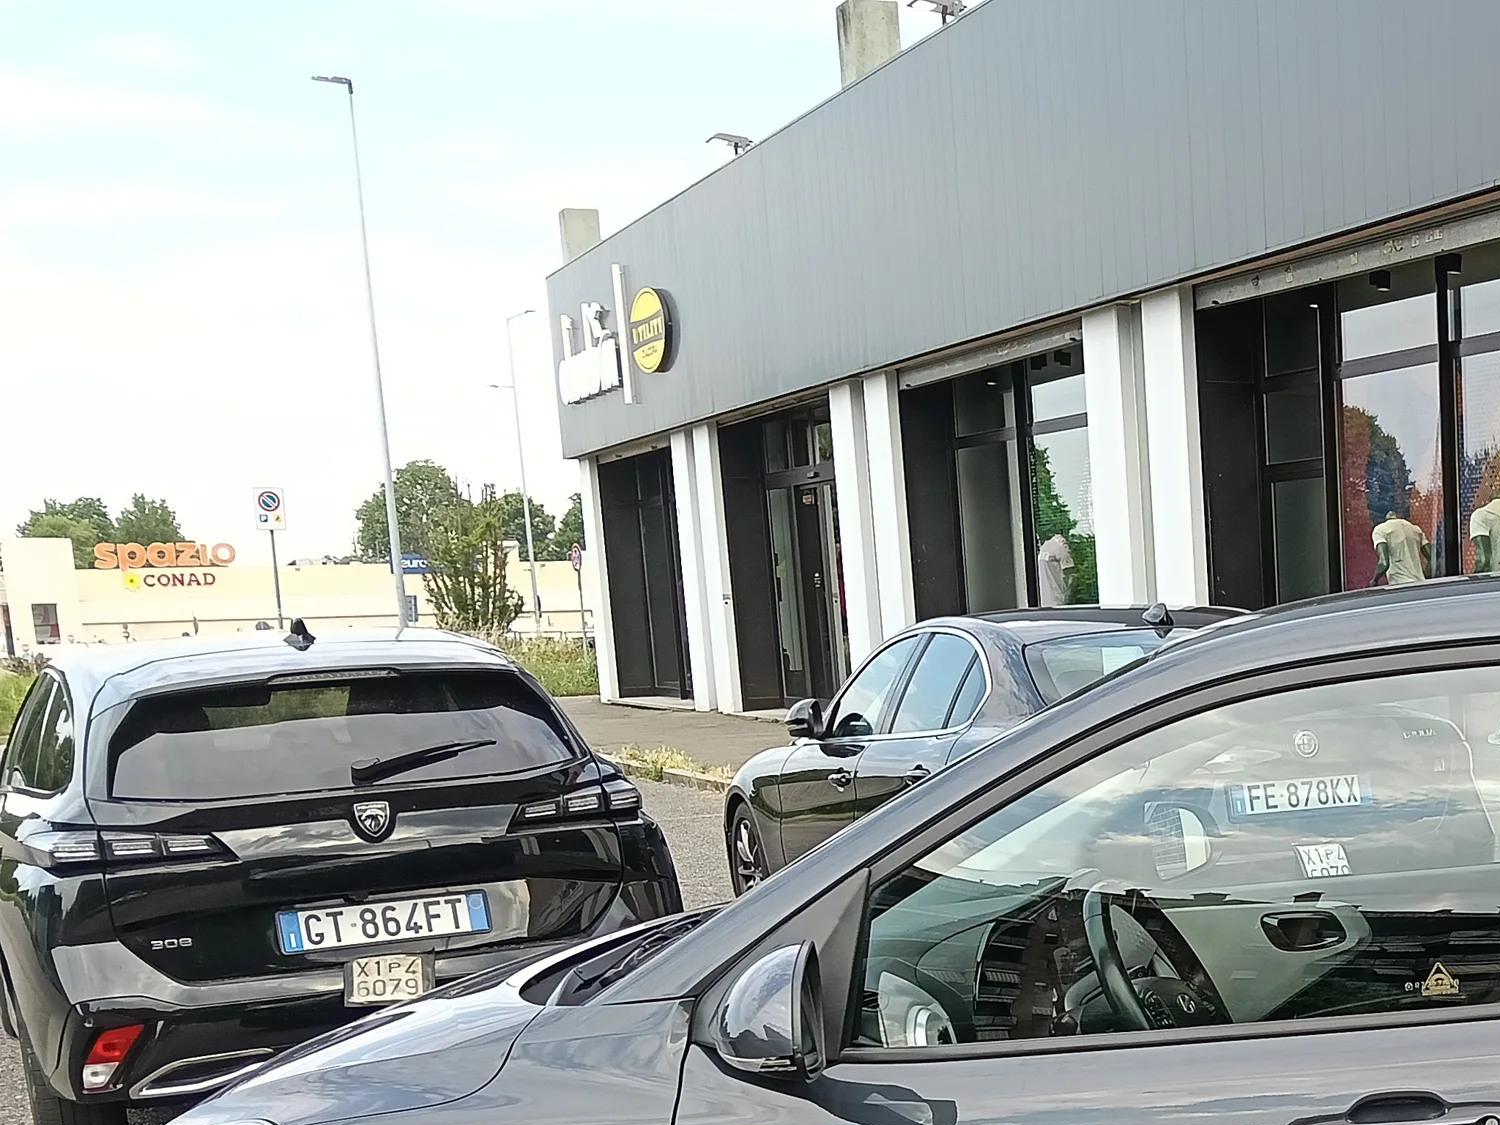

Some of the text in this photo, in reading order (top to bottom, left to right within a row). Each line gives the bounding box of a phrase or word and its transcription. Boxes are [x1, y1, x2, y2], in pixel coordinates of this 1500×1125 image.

[94, 541, 236, 572] spazio
[143, 573, 216, 587] CONAD
[1247, 776, 1359, 812] FE 878KX
[304, 898, 463, 946] GT 864FT
[150, 937, 193, 951] 308
[356, 977, 420, 998] 6079
